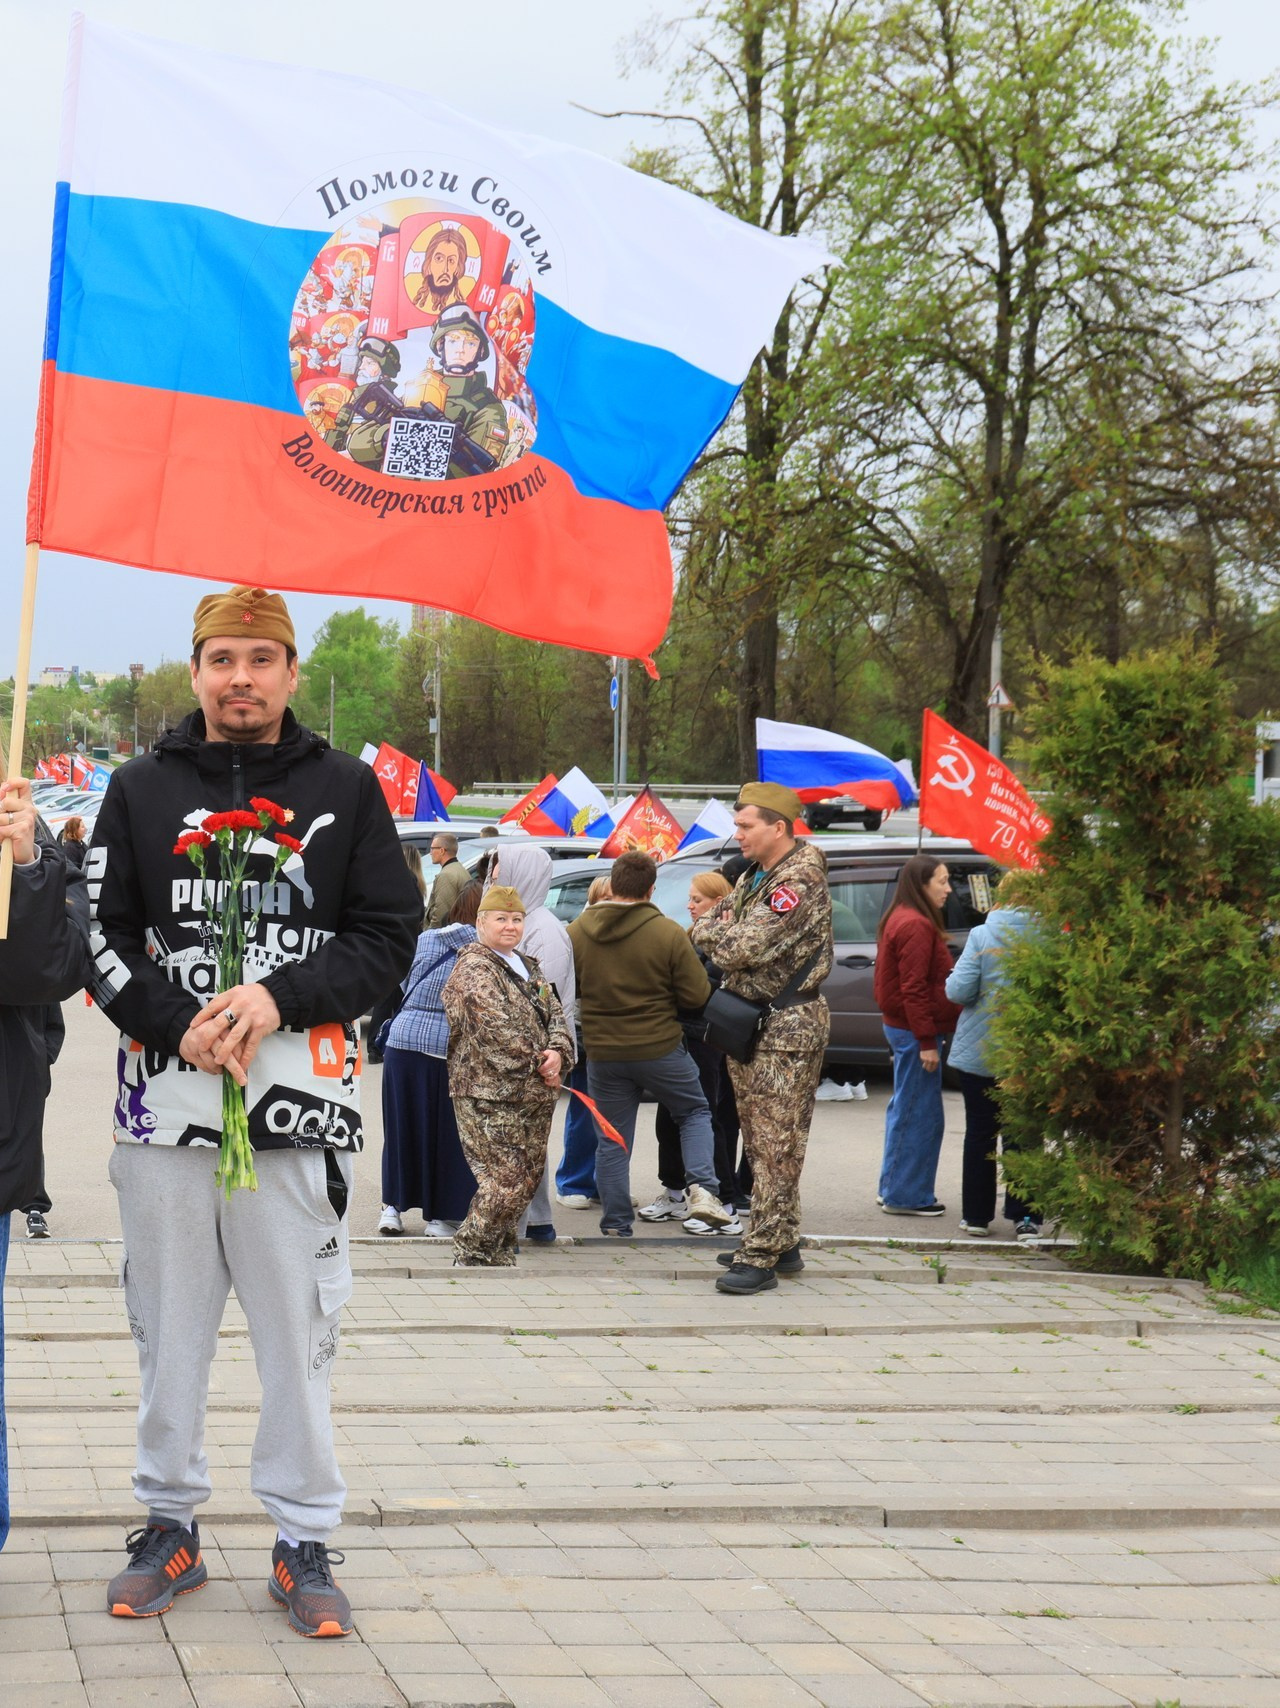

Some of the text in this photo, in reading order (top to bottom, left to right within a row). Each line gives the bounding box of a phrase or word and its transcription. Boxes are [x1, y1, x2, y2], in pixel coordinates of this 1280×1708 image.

[316, 168, 552, 276] Помоги Своим
[280, 430, 549, 519] Волонтерская группа
[990, 820, 1017, 849] 79
[171, 878, 291, 916] PUMA
[315, 1249, 340, 1259] adidas
